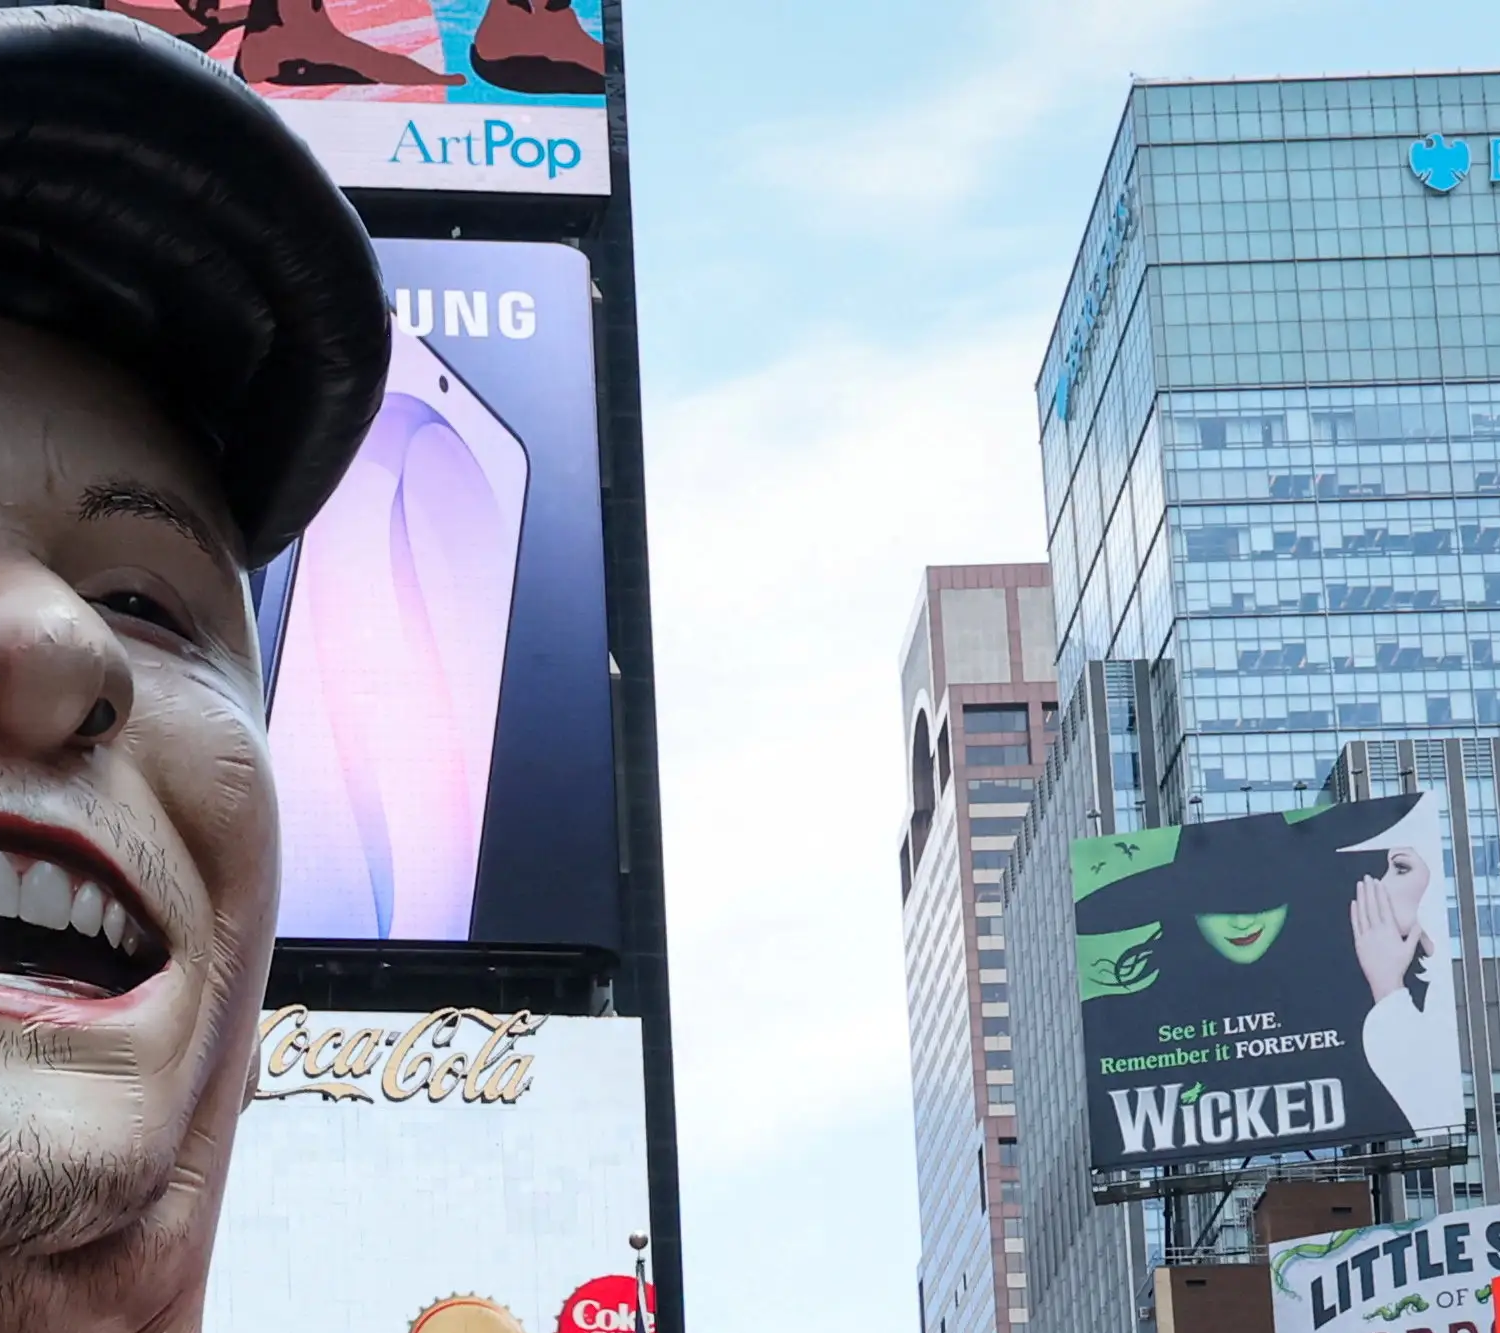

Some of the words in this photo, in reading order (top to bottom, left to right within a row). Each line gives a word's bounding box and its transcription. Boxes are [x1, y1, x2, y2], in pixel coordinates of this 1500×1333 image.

[389, 118, 582, 179] ArtPop
[1158, 1024, 1196, 1043] See
[1200, 1019, 1218, 1038] it
[1222, 1012, 1282, 1035] LIVE.
[1100, 1047, 1210, 1075] Remember
[1215, 1044, 1231, 1062] it
[1235, 1029, 1346, 1060] FOREVER.
[1310, 1222, 1474, 1331] LITTLE
[1436, 1288, 1469, 1310] OF
